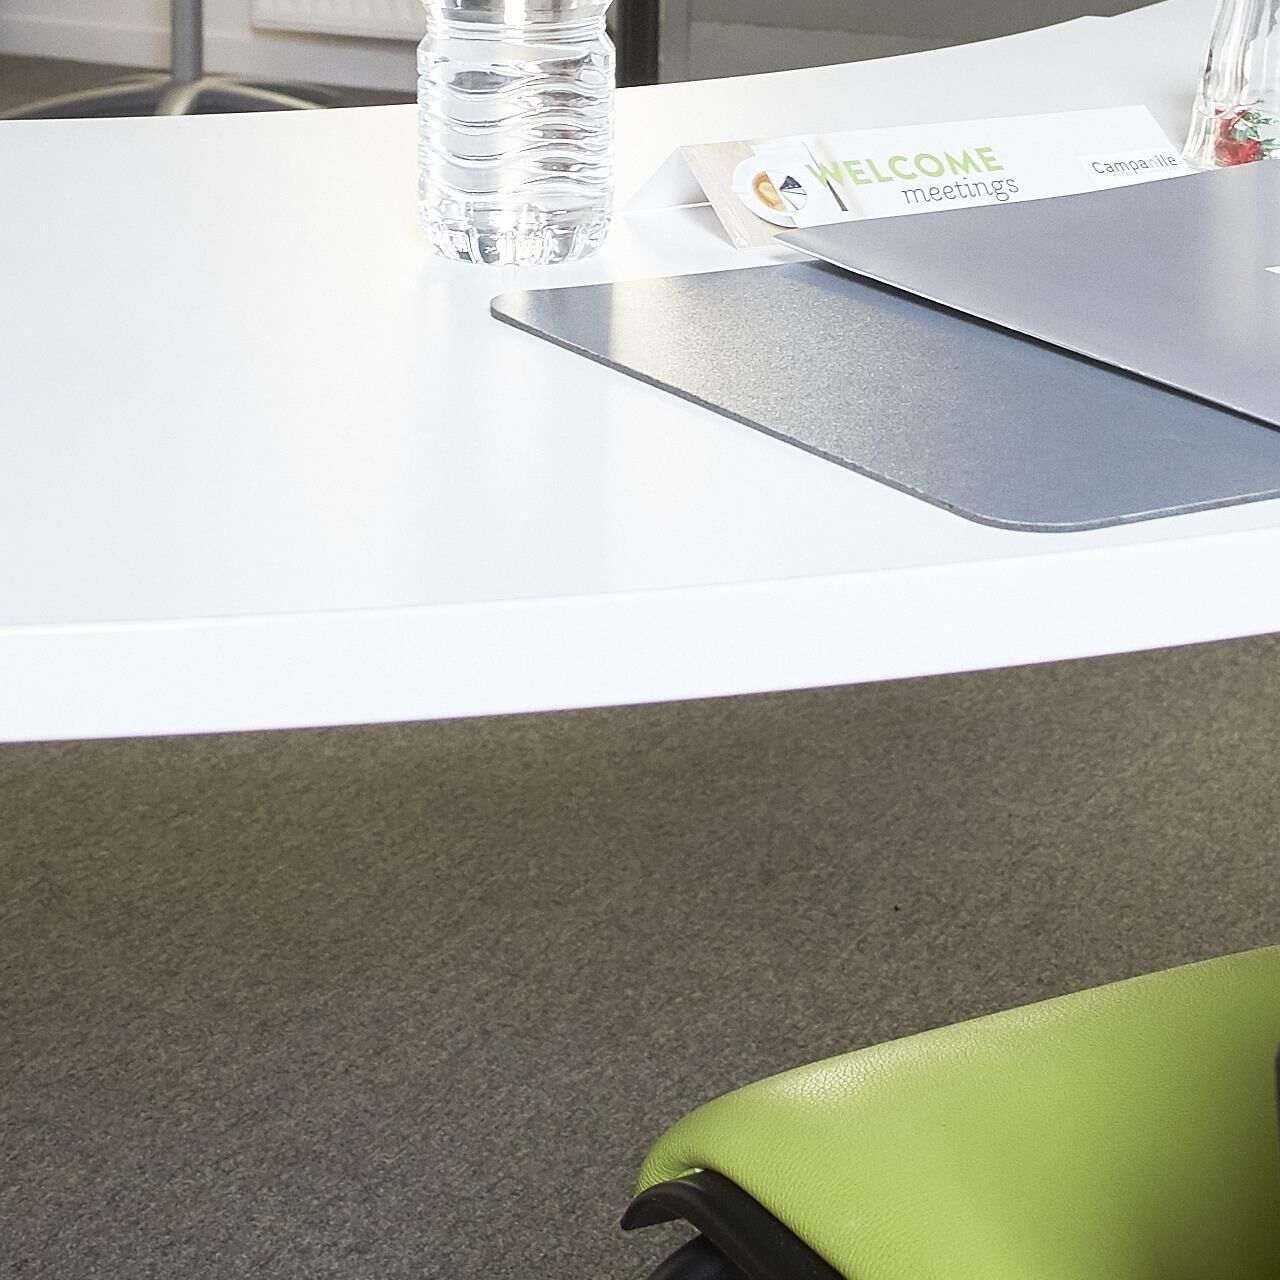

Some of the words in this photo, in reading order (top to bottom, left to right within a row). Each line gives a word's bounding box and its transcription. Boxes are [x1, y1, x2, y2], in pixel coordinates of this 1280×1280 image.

[805, 146, 1005, 187] WELCOME
[1091, 153, 1178, 174] Campanile
[901, 176, 1019, 204] meetings
